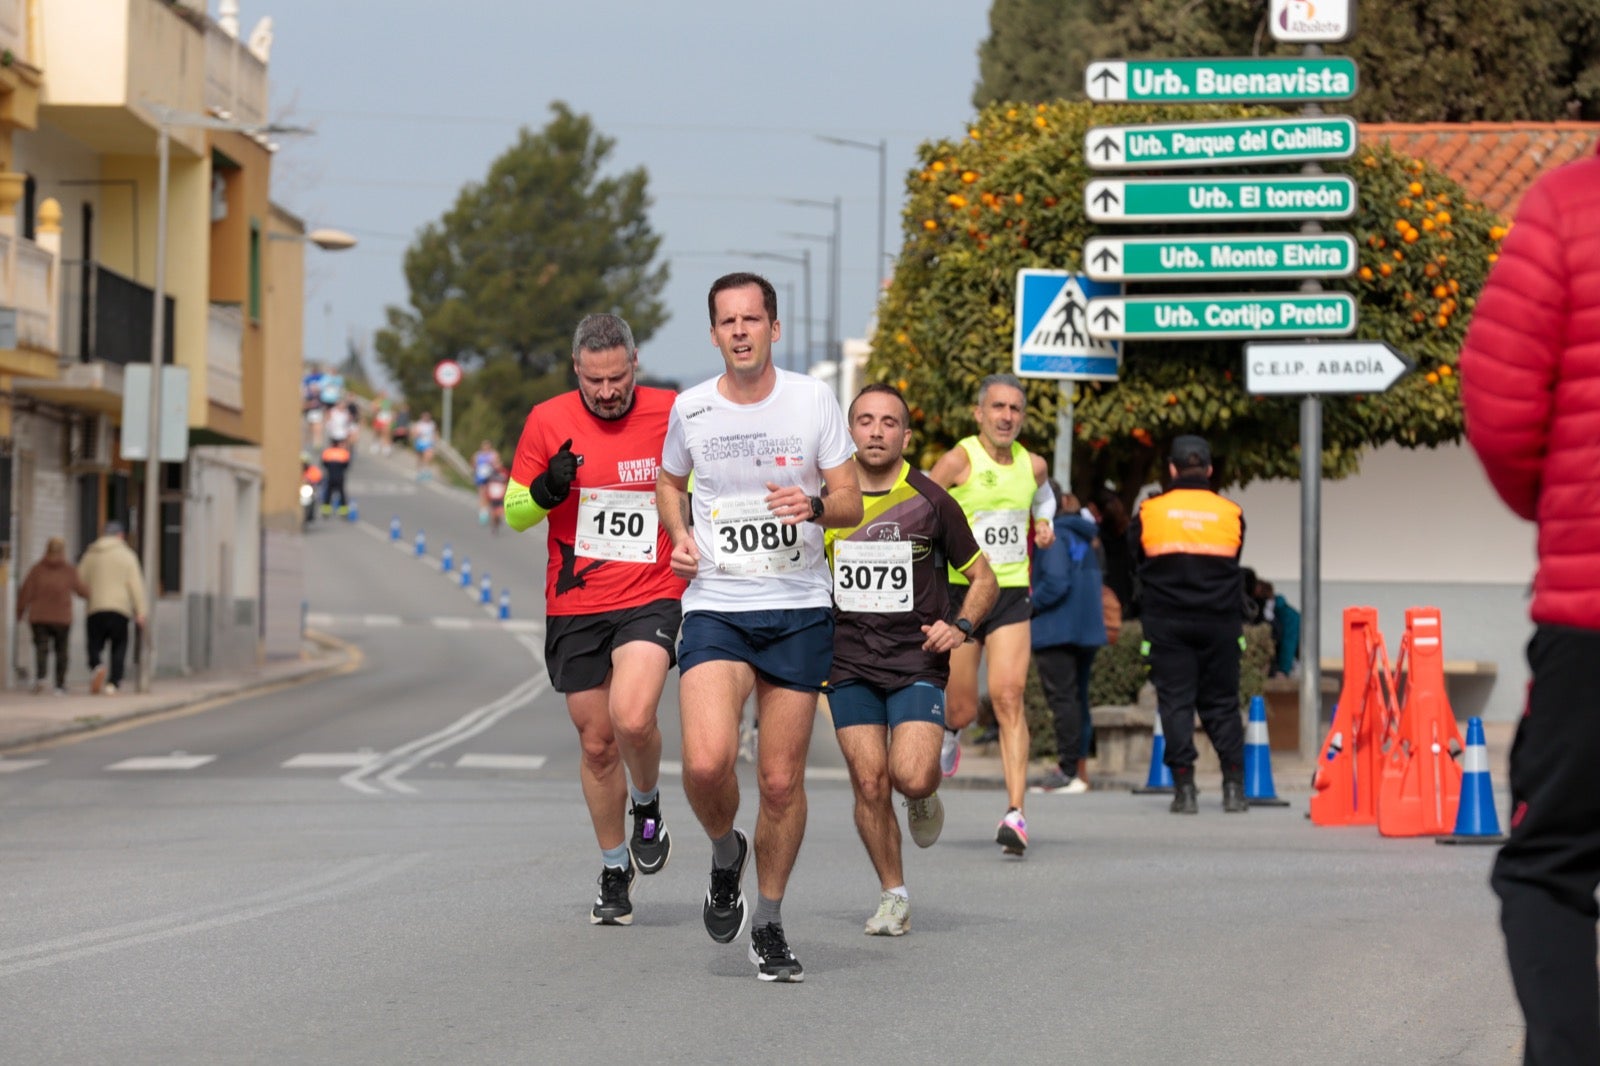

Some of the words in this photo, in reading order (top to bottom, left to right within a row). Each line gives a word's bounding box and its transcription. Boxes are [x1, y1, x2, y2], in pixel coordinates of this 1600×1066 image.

[1132, 68, 1190, 95] Urb.
[1195, 66, 1350, 95] Buenavista
[1129, 134, 1168, 157] Urb.
[1171, 132, 1235, 157] Parque
[1238, 129, 1268, 152] del
[1271, 126, 1344, 151] Cubillas
[1188, 186, 1233, 208] Urb.
[1239, 187, 1261, 207] El
[1265, 185, 1343, 207] torreón
[1160, 246, 1205, 268] Urb.
[1210, 245, 1278, 267] Monte
[1283, 243, 1342, 266] Elvira
[1154, 305, 1199, 327] Urb.
[1204, 304, 1275, 330] Cortijo
[1280, 302, 1343, 325] Pretel
[1252, 360, 1309, 376] C.E.I.P.
[1317, 356, 1385, 375] ABADÍA
[719, 432, 767, 442] TotalEnergies
[720, 440, 755, 451] Media
[759, 435, 803, 448] maratón
[617, 457, 656, 471] RUNNING
[704, 450, 740, 462] CIUDAD
[743, 448, 755, 457] DE
[757, 446, 802, 456] GRANADA
[593, 510, 644, 538] 150
[984, 525, 1019, 545] 693
[719, 522, 798, 554] 3080
[839, 565, 907, 591] 3079
